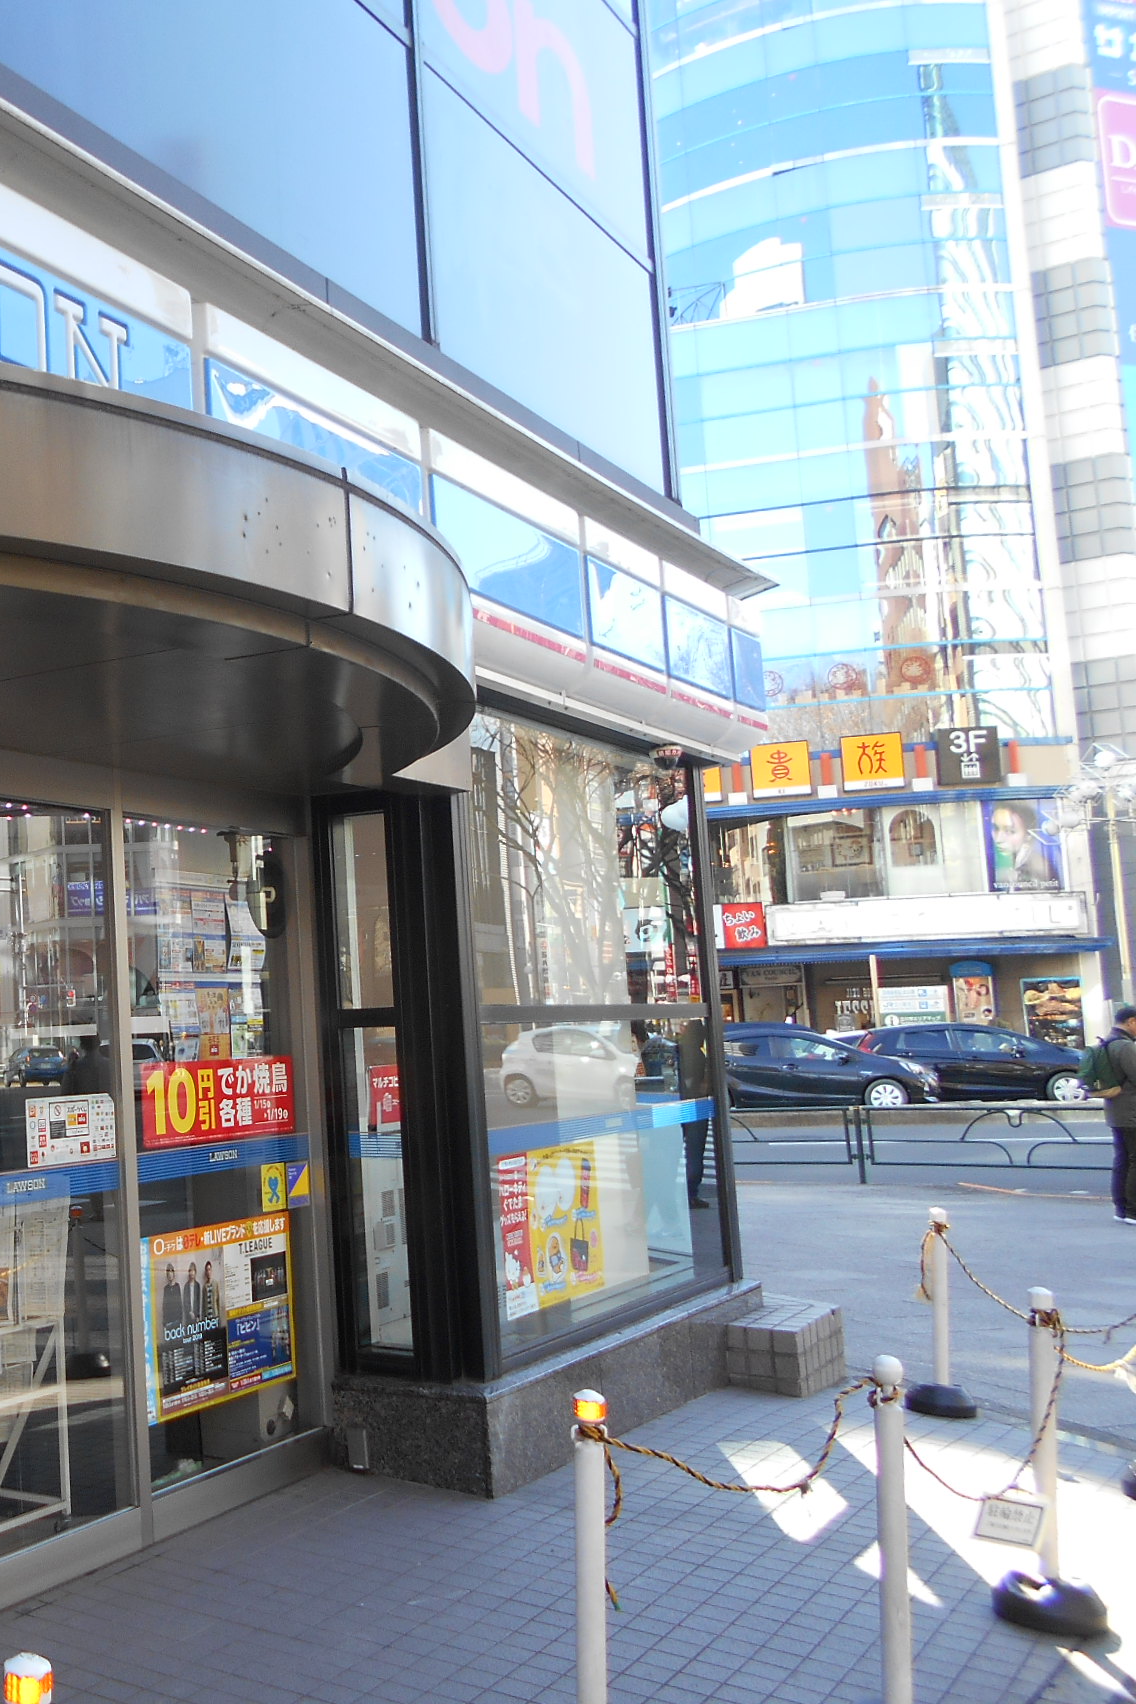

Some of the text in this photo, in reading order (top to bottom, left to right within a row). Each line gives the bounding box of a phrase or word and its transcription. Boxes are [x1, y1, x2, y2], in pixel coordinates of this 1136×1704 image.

[856, 740, 888, 775] 族
[950, 729, 987, 754] 3F
[766, 749, 793, 782] 貴
[217, 1062, 288, 1096] でか焼鳥
[146, 1067, 197, 1135] 10
[219, 1097, 253, 1128] 各種
[209, 1149, 238, 1163] LAWSON
[6, 1177, 46, 1194] LAWSON
